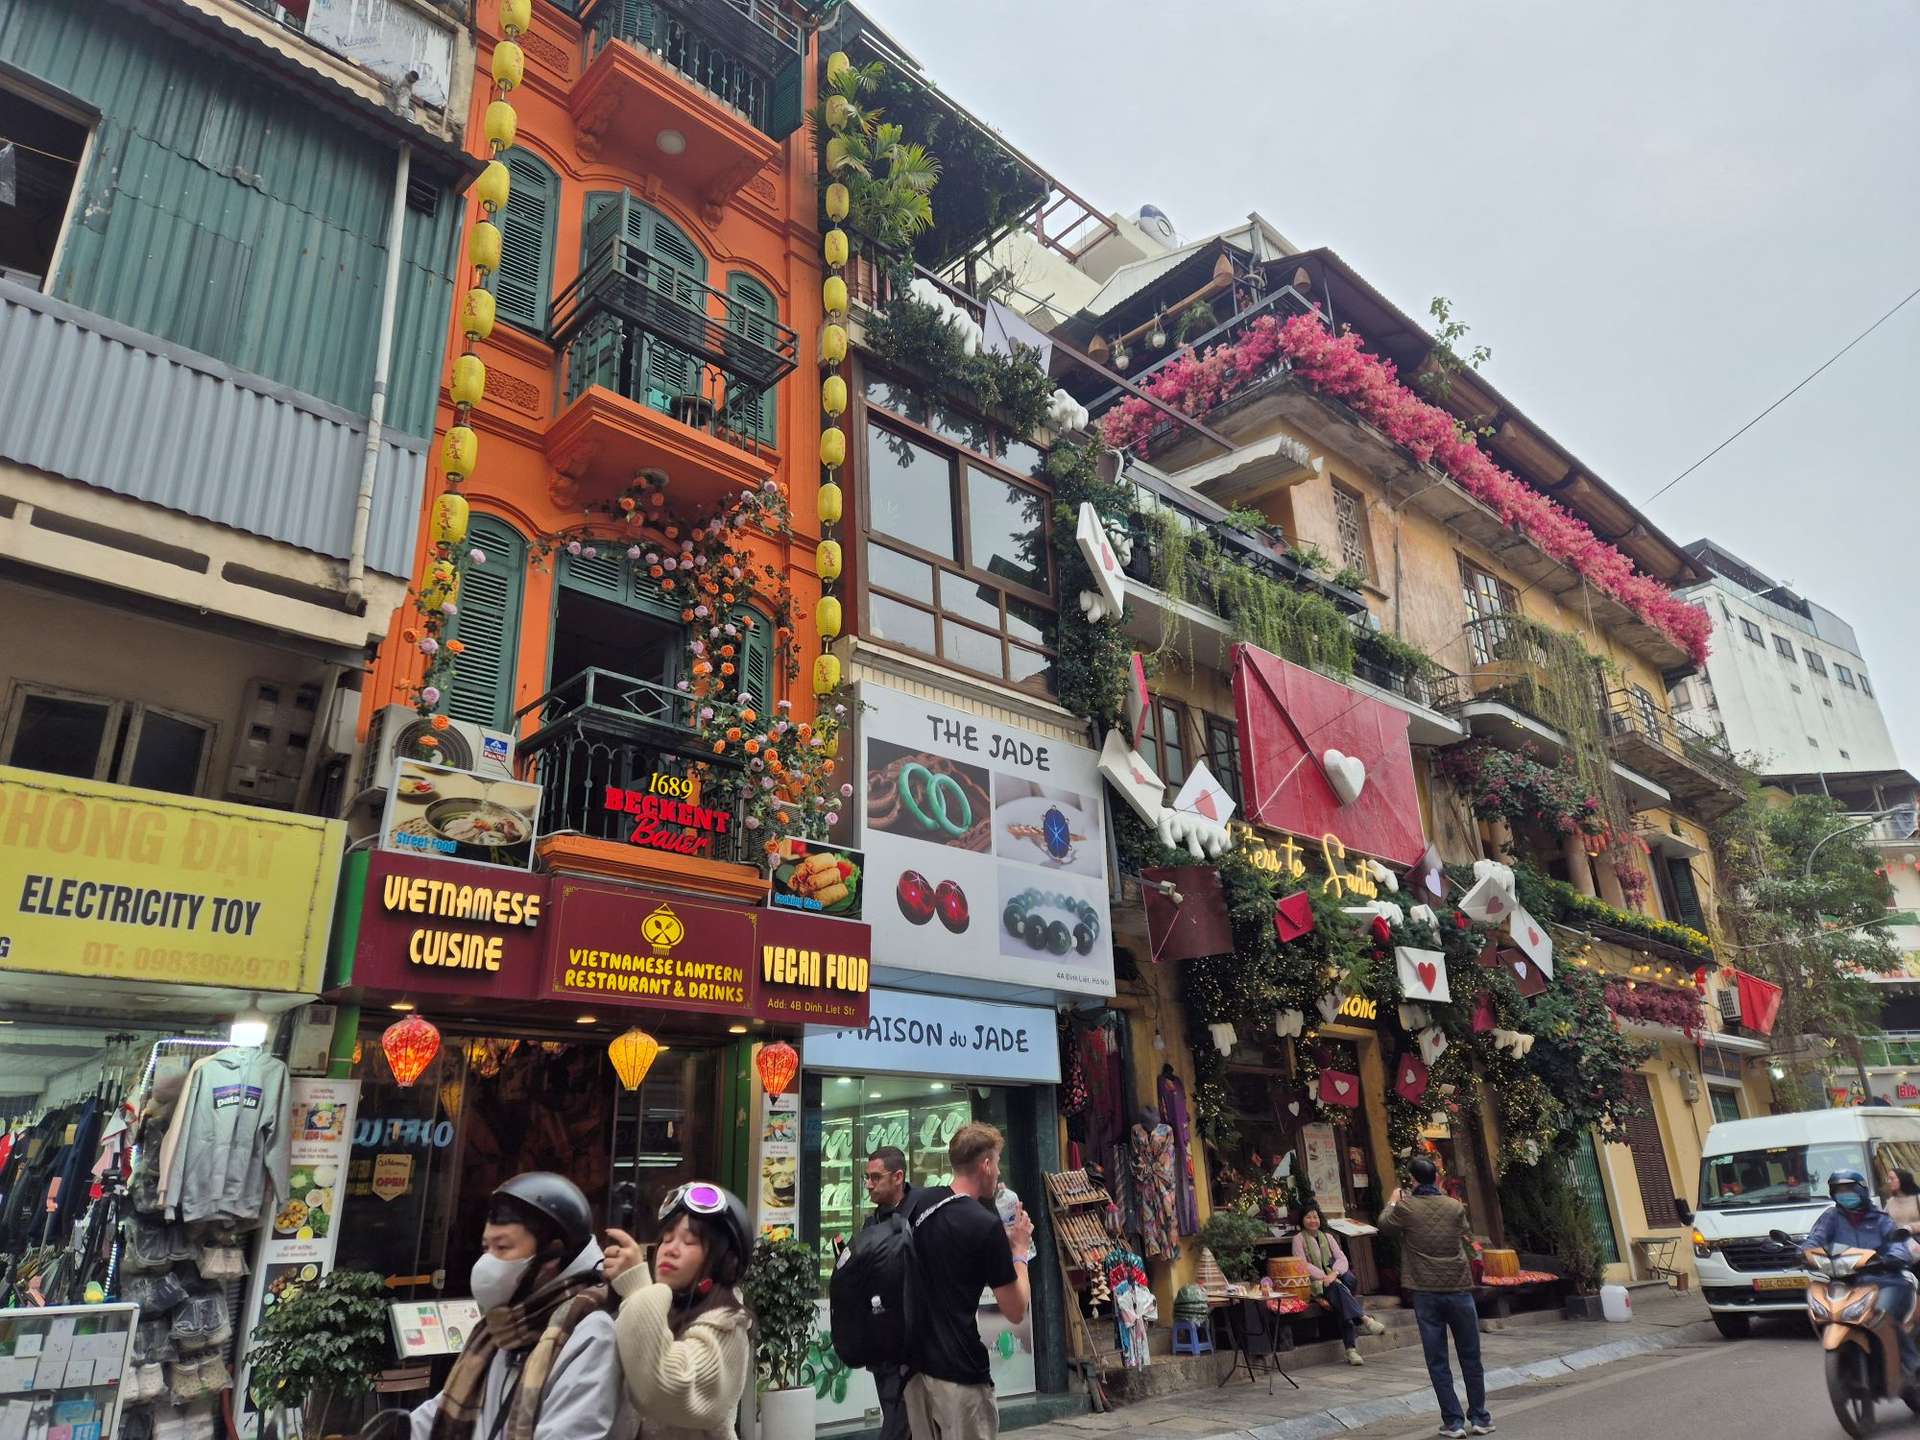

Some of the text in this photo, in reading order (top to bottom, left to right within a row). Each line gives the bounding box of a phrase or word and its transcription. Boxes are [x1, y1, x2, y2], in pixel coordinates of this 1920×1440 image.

[927, 715, 1050, 771] THE JADE
[649, 772, 693, 799] 1689
[604, 784, 731, 833] BECKENT
[630, 814, 710, 855] Bauer
[1281, 836, 1306, 878] to
[19, 874, 261, 936] ELECTRICITY TOY
[384, 875, 540, 927] VIETNAMESE
[409, 929, 503, 971] CUISINE
[569, 948, 743, 983] VIETNAMESE LANTERN
[763, 945, 868, 992] VEGAN FOOD
[565, 969, 744, 1002] RESTAURANT & DRINKS
[767, 998, 856, 1015] Add: 4B Dinh Liet Str
[949, 1031, 967, 1048] du
[972, 1025, 1029, 1052] JADE
